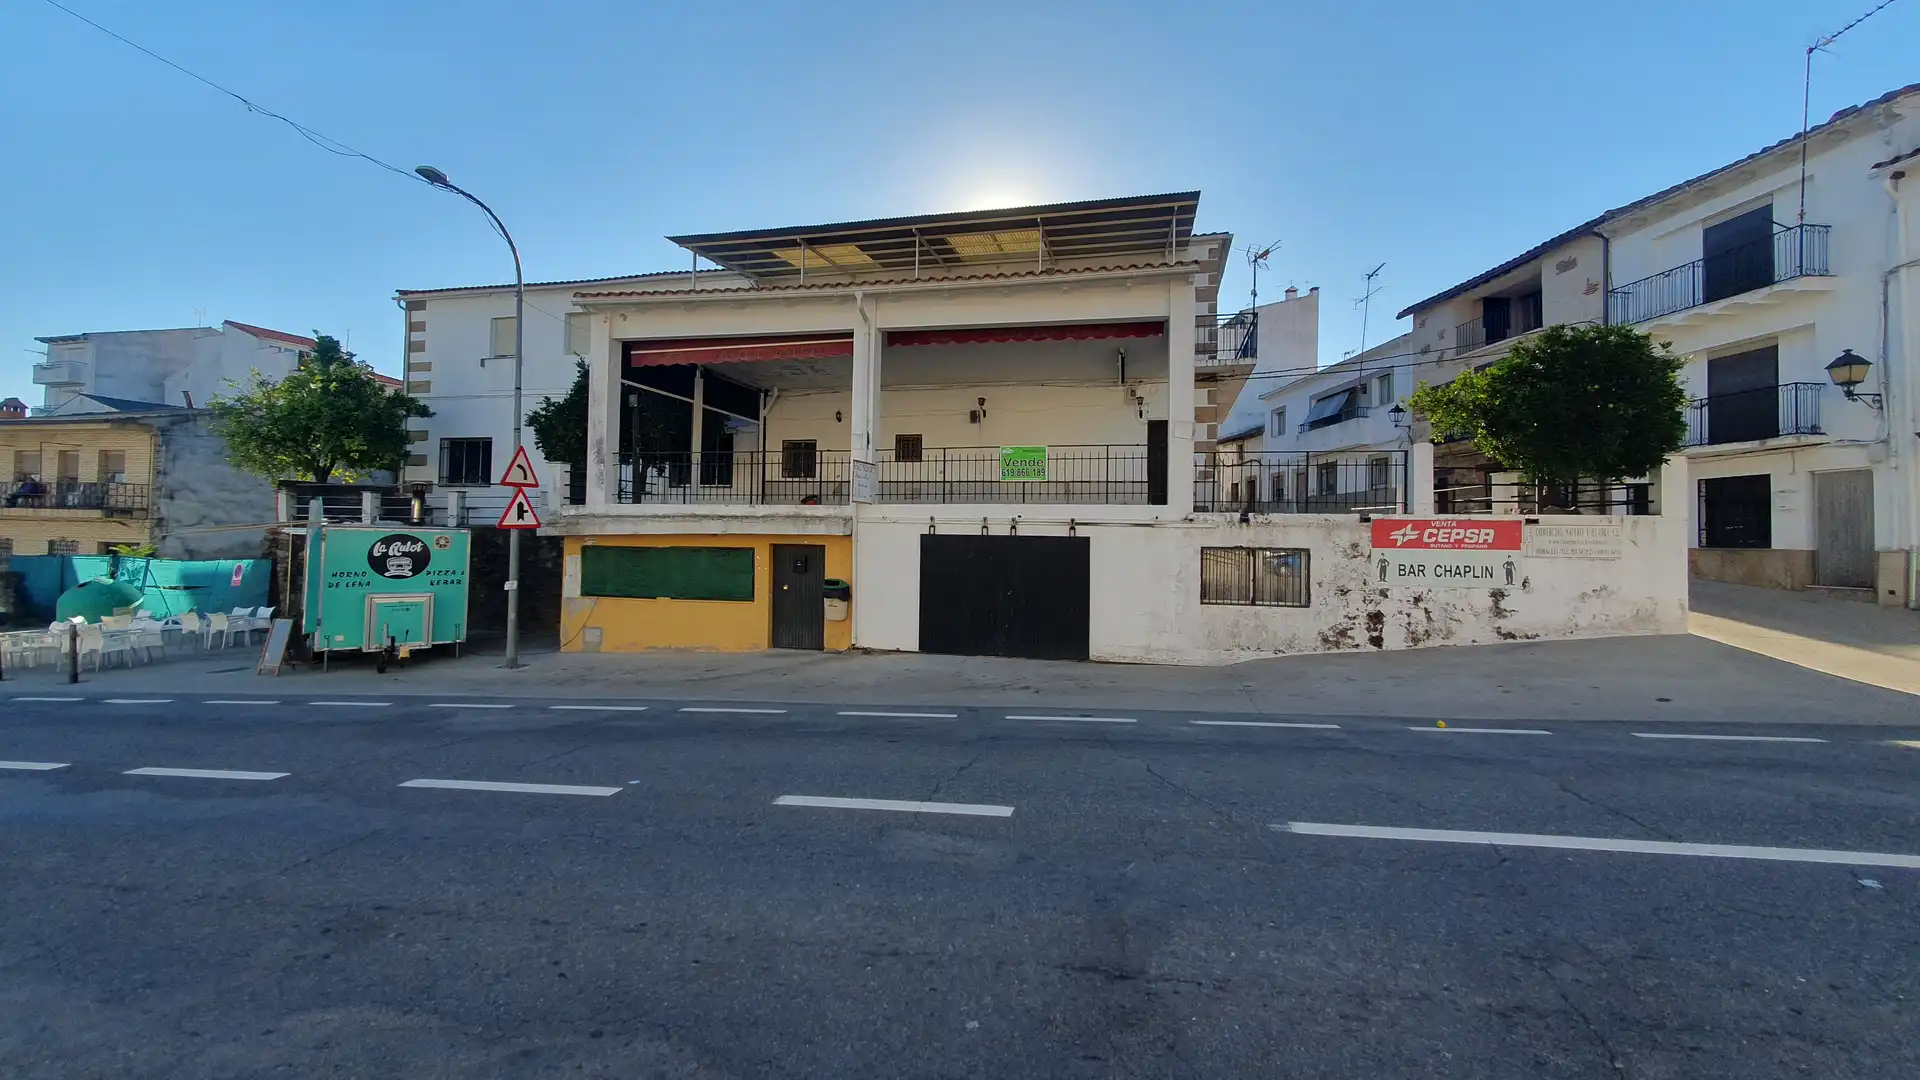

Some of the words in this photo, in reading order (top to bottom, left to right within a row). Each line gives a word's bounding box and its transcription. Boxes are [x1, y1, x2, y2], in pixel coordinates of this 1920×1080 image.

[1003, 457, 1044, 467] Vende
[1001, 468, 1015, 477] 619
[1033, 468, 1046, 477] 189
[1422, 528, 1495, 544] CEPSA
[373, 541, 388, 557] La
[1398, 563, 1427, 578] BAR
[1433, 563, 1494, 579] CHAPLIN
[327, 581, 340, 589] DE
